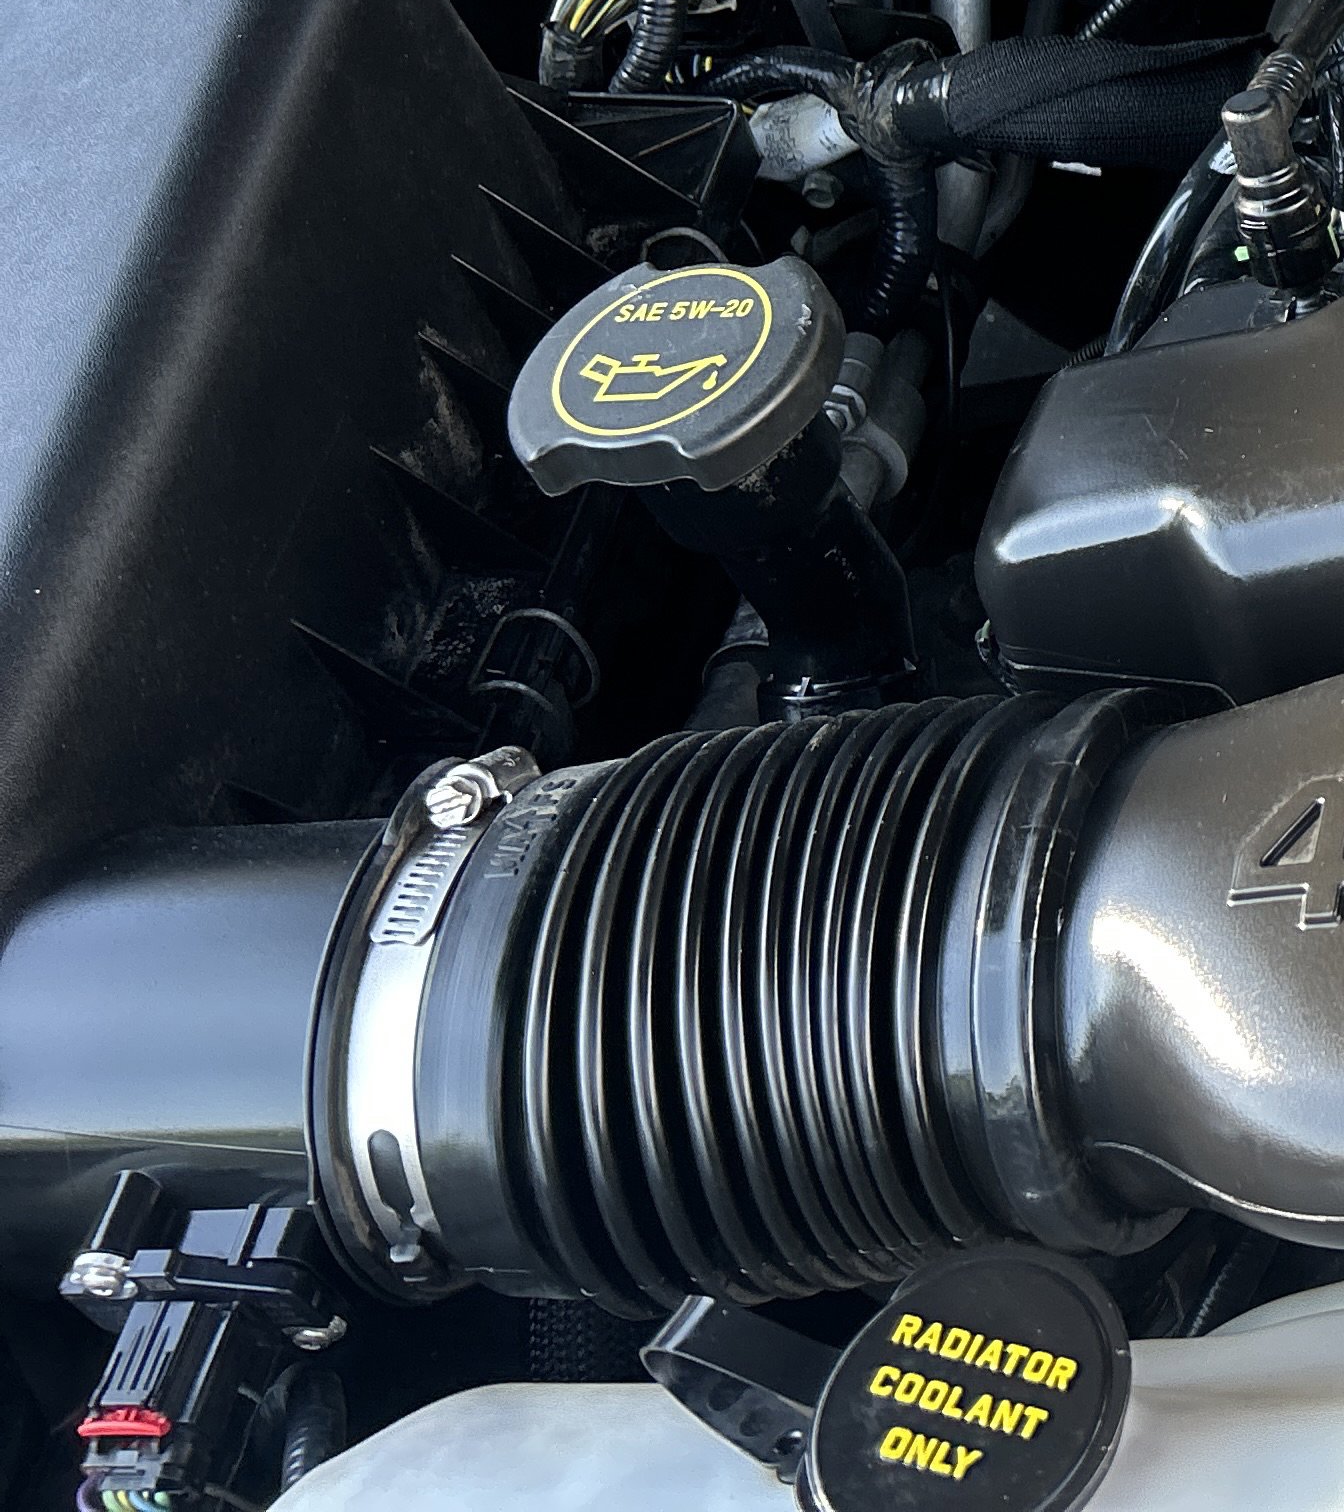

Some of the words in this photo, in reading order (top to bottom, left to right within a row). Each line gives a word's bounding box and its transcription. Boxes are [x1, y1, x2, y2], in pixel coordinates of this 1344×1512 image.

[614, 301, 669, 323] SAE
[668, 298, 755, 321] 5W-20
[890, 1312, 1079, 1392] RADIATOR
[868, 1364, 1050, 1440] COOLANT
[878, 1425, 984, 1481] ONLY
